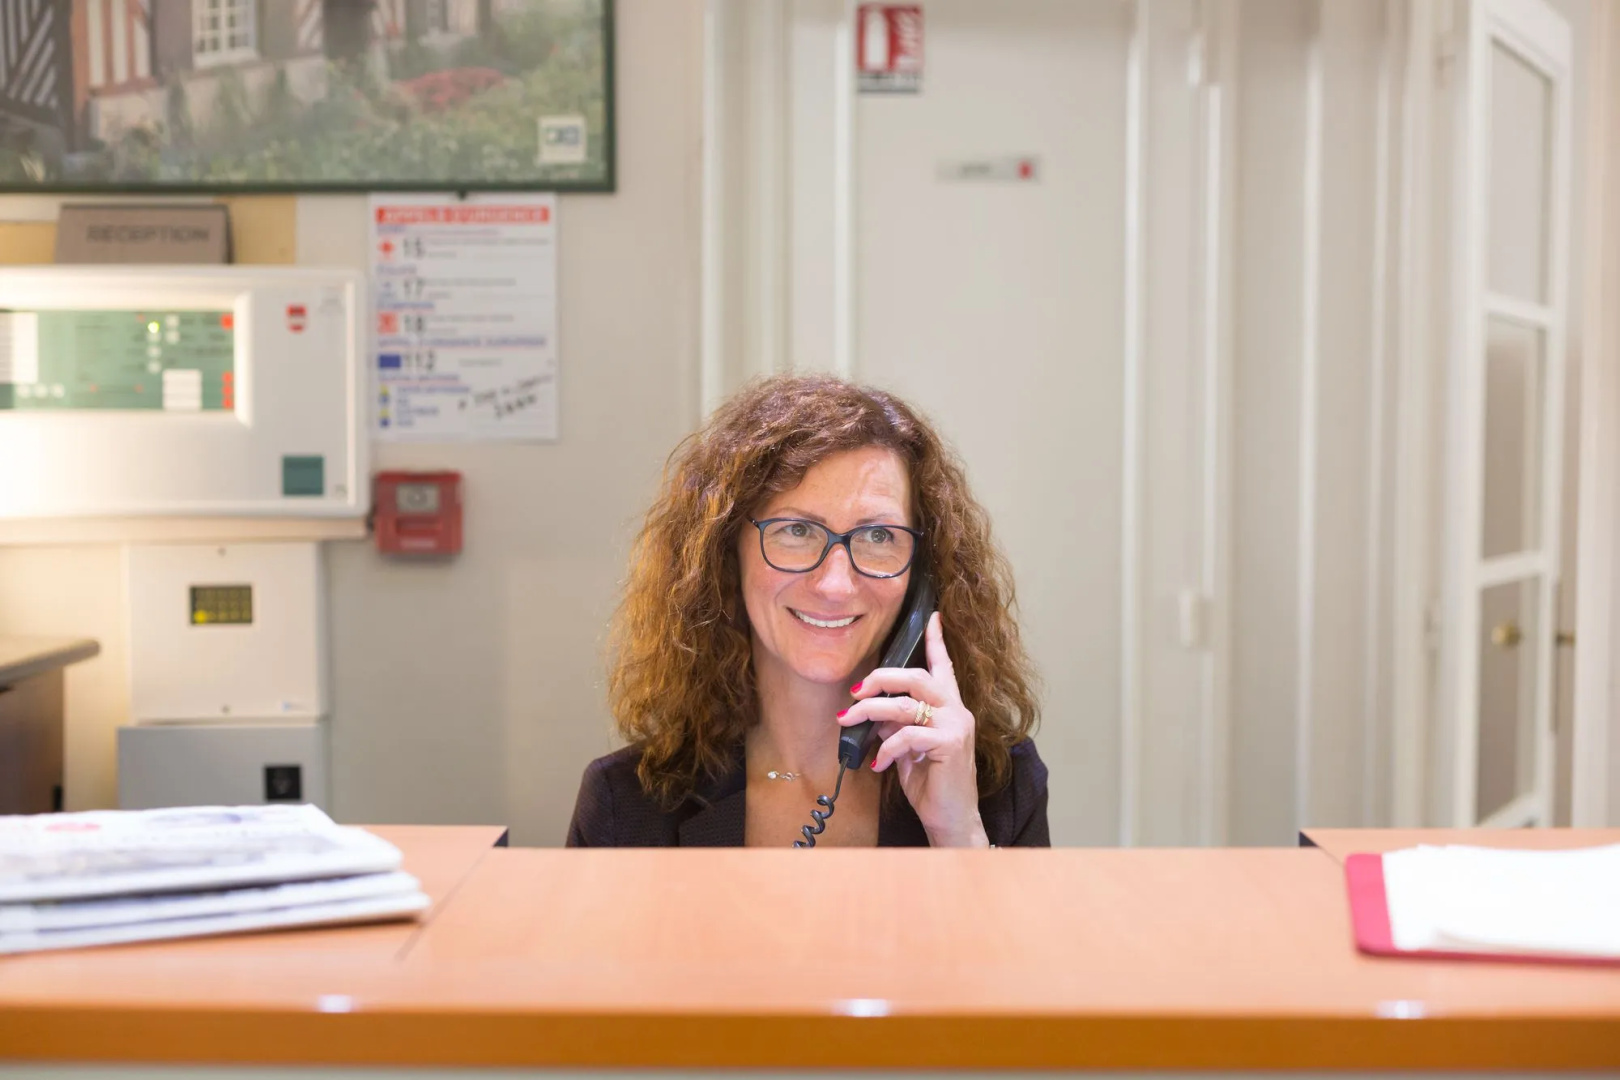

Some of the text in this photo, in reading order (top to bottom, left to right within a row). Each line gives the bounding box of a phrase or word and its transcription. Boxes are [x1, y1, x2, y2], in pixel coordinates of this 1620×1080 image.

[402, 237, 425, 258] 15
[402, 278, 425, 299] 17
[402, 313, 425, 334] 18
[403, 351, 435, 371] 112
